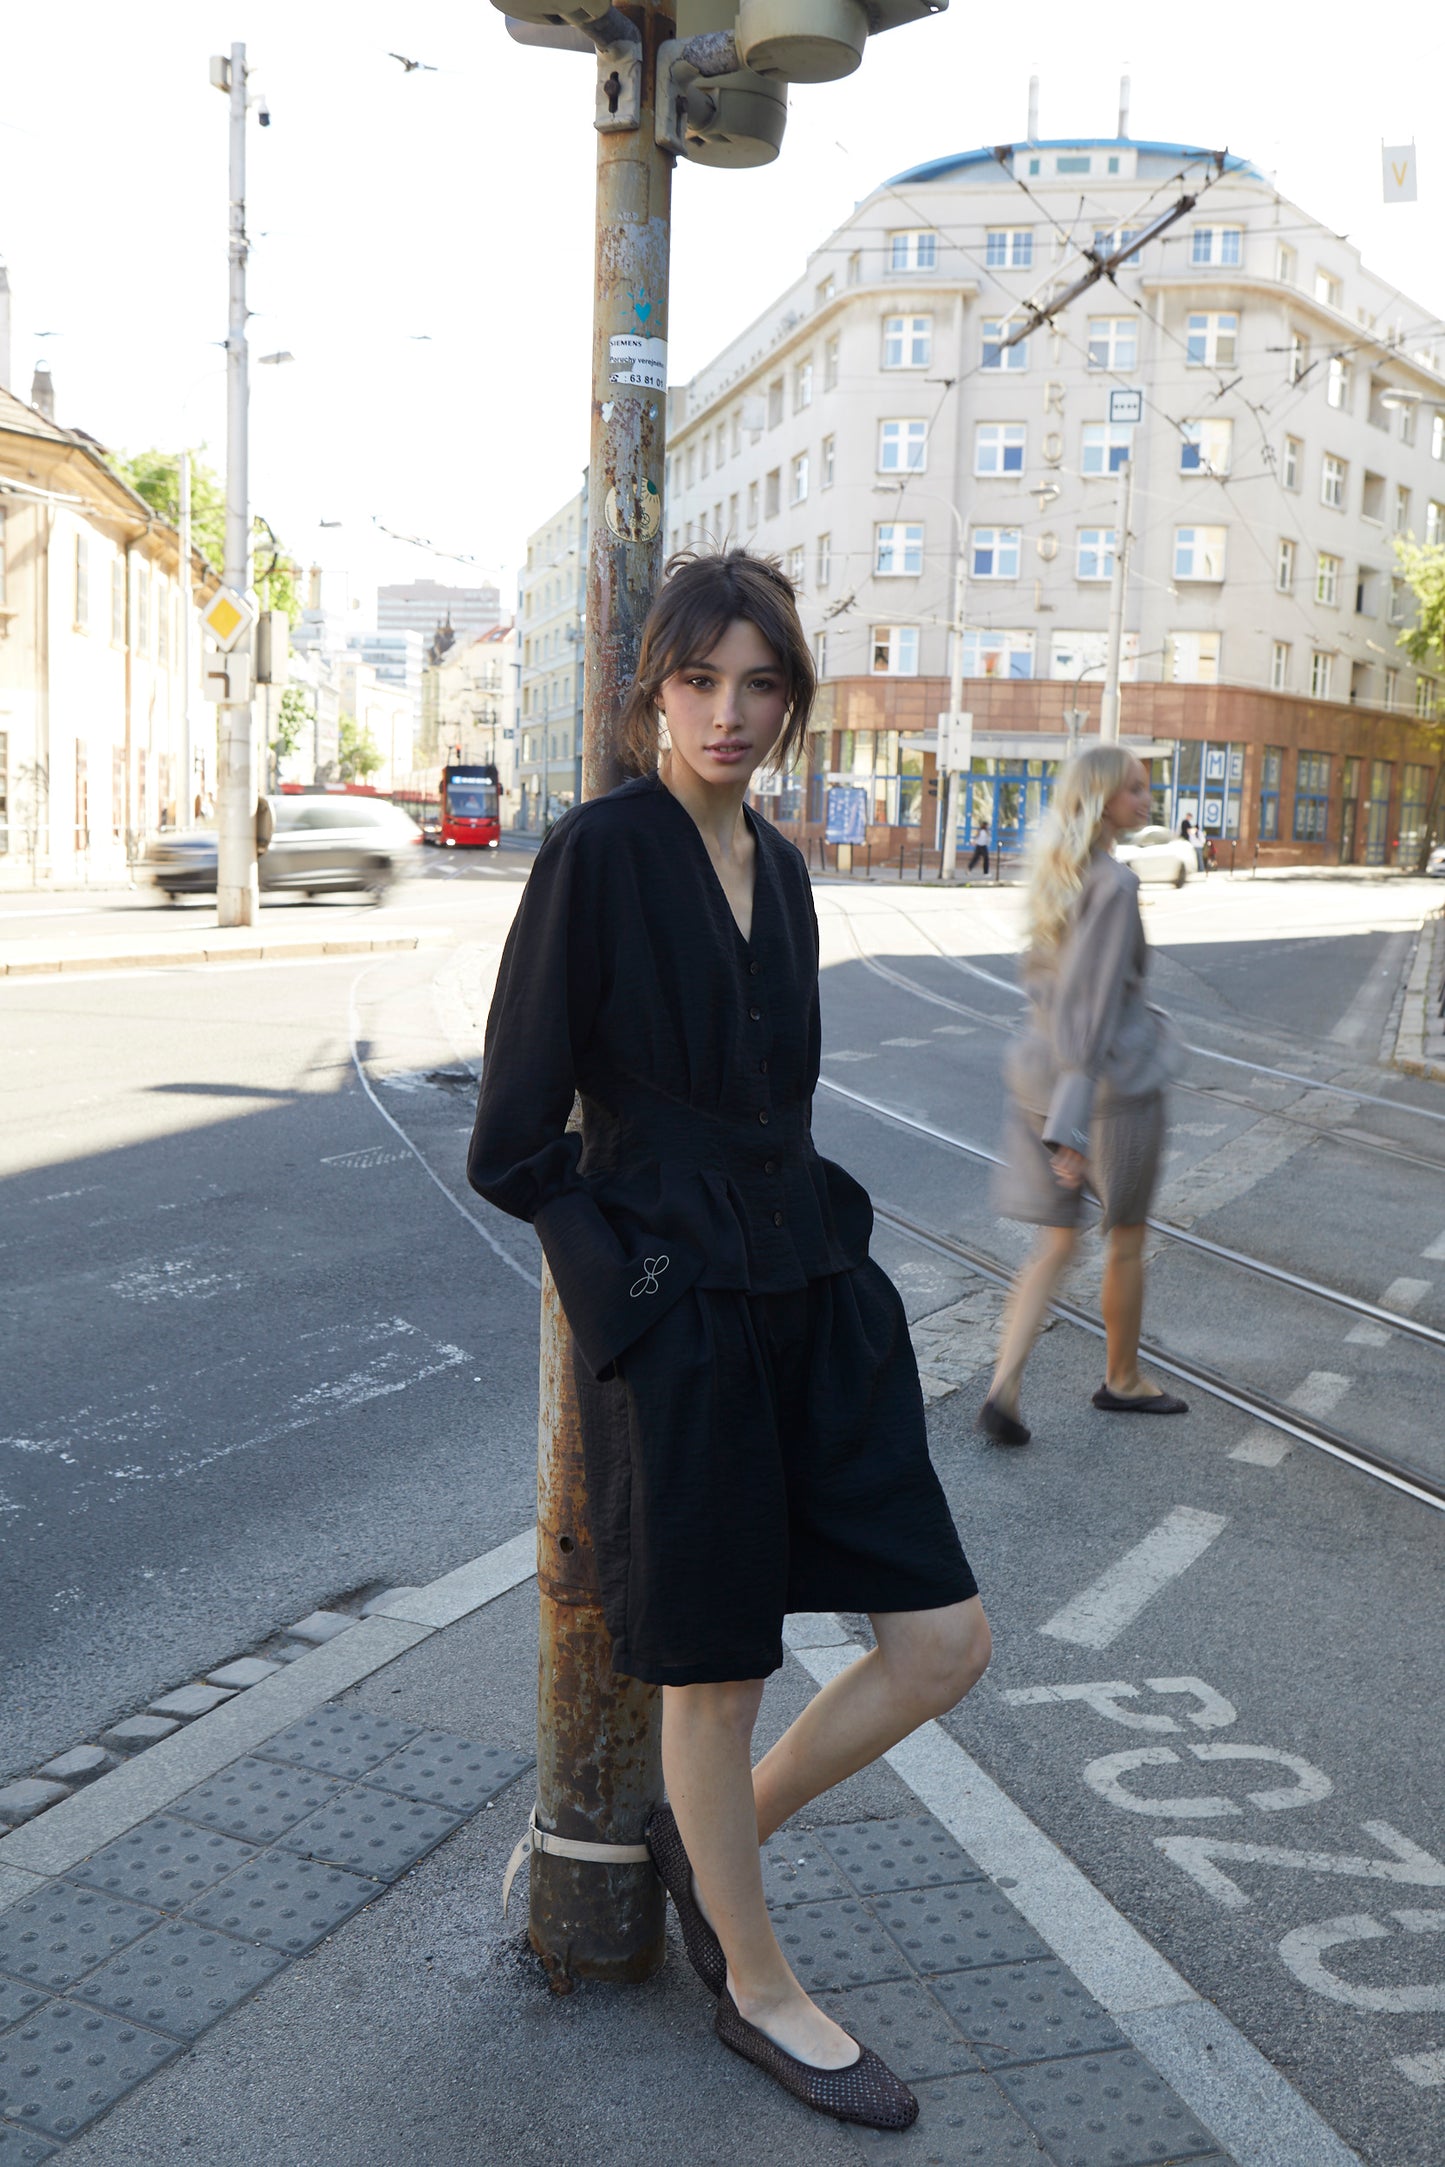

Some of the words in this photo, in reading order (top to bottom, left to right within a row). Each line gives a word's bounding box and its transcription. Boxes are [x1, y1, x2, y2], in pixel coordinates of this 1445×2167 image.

[1391, 160, 1408, 188] V
[630, 374, 641, 383] 63
[644, 376, 654, 385] 81
[1004, 1676, 1445, 2087] POZO
